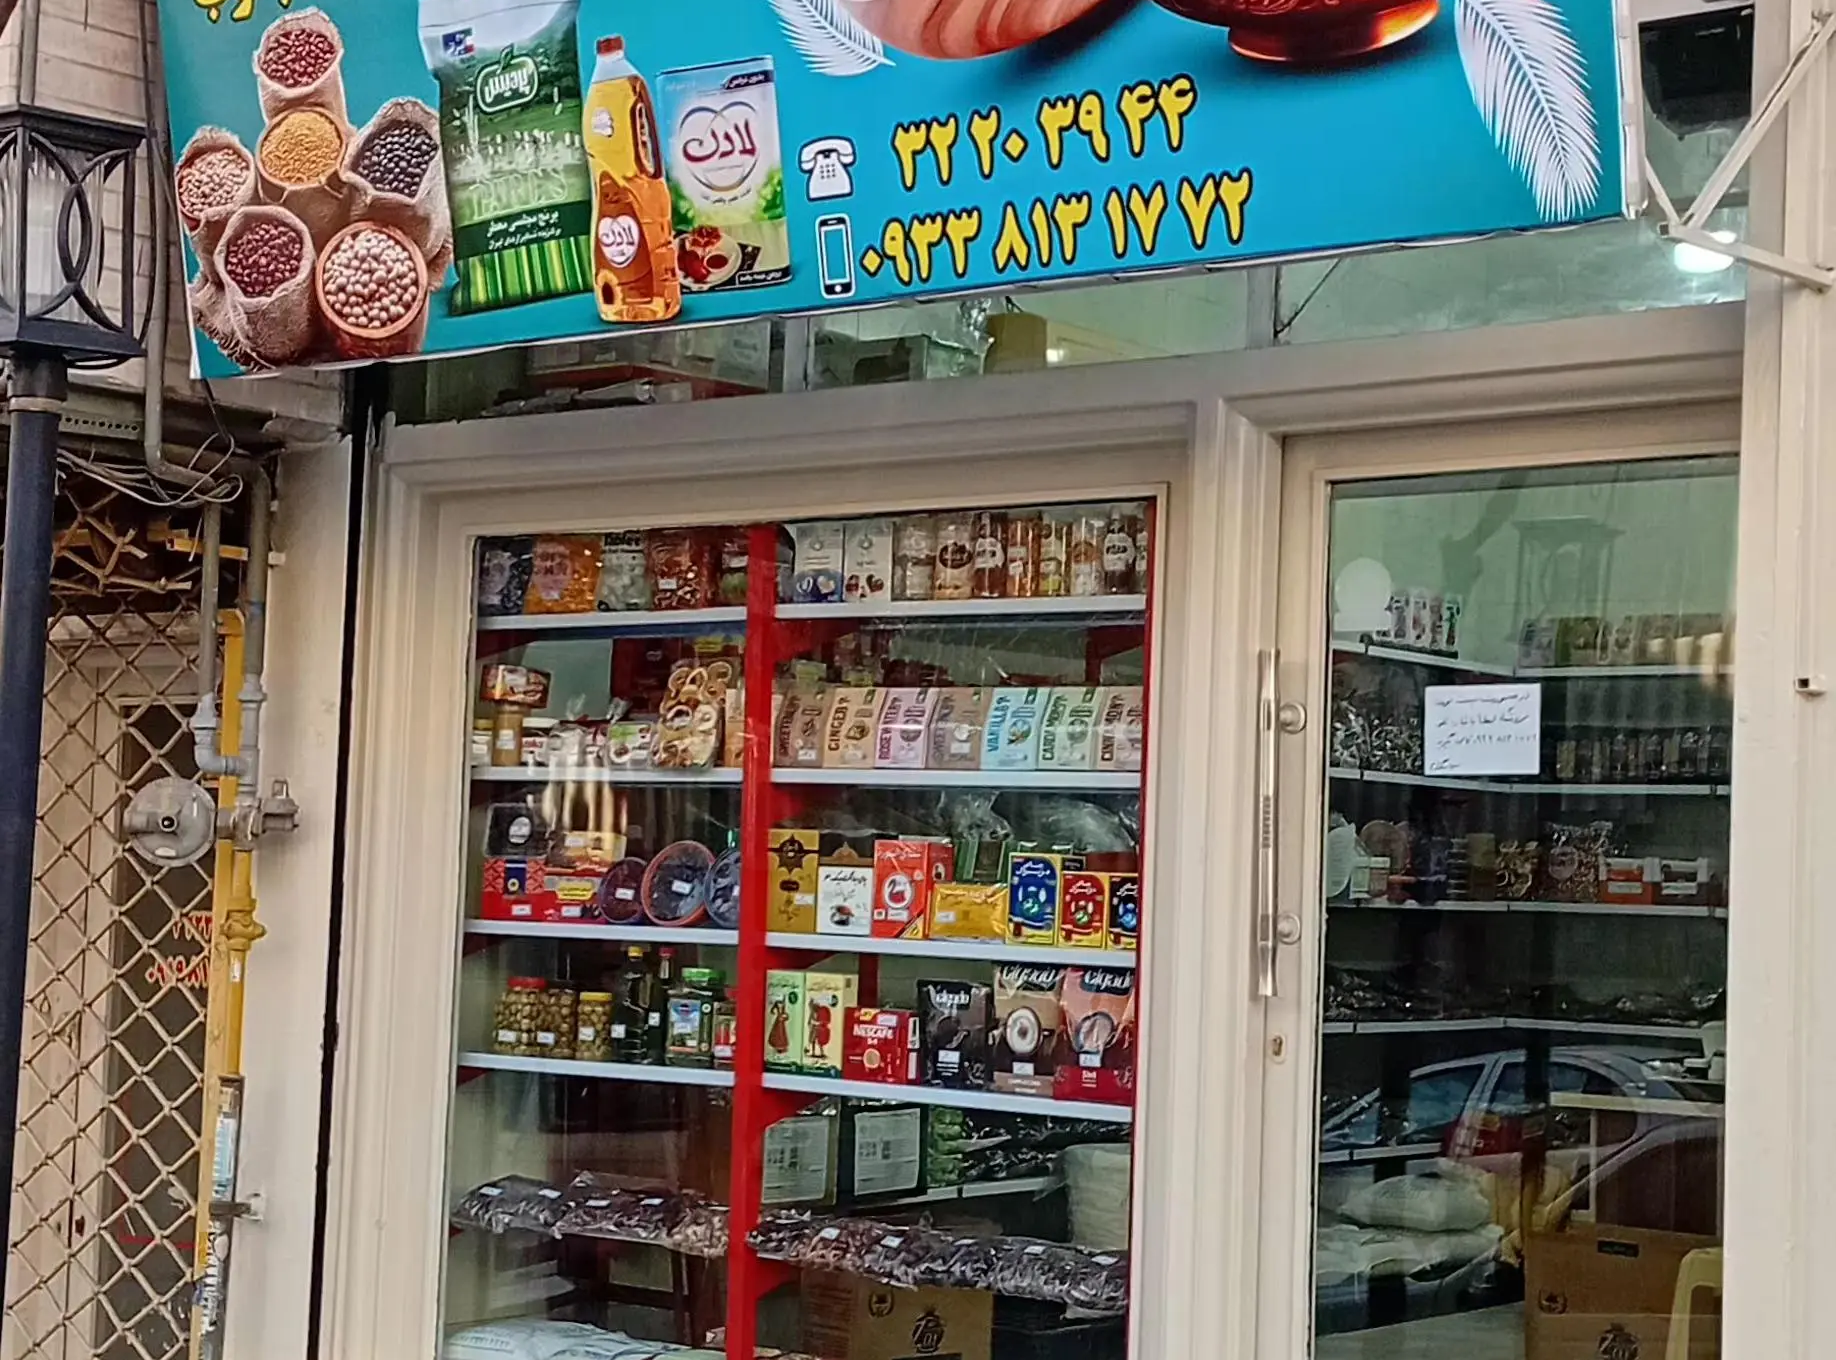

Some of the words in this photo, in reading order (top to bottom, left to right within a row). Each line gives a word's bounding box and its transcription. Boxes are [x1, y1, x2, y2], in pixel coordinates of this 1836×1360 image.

[682, 117, 757, 163] لادن
[892, 112, 957, 192] ۳۲
[968, 104, 1028, 181] ۲۰
[1036, 89, 1110, 170] ۳۹
[1120, 73, 1198, 153] ۴۴
[859, 208, 980, 288] ۰۹۳۳
[992, 191, 1091, 275] ۸۱۳
